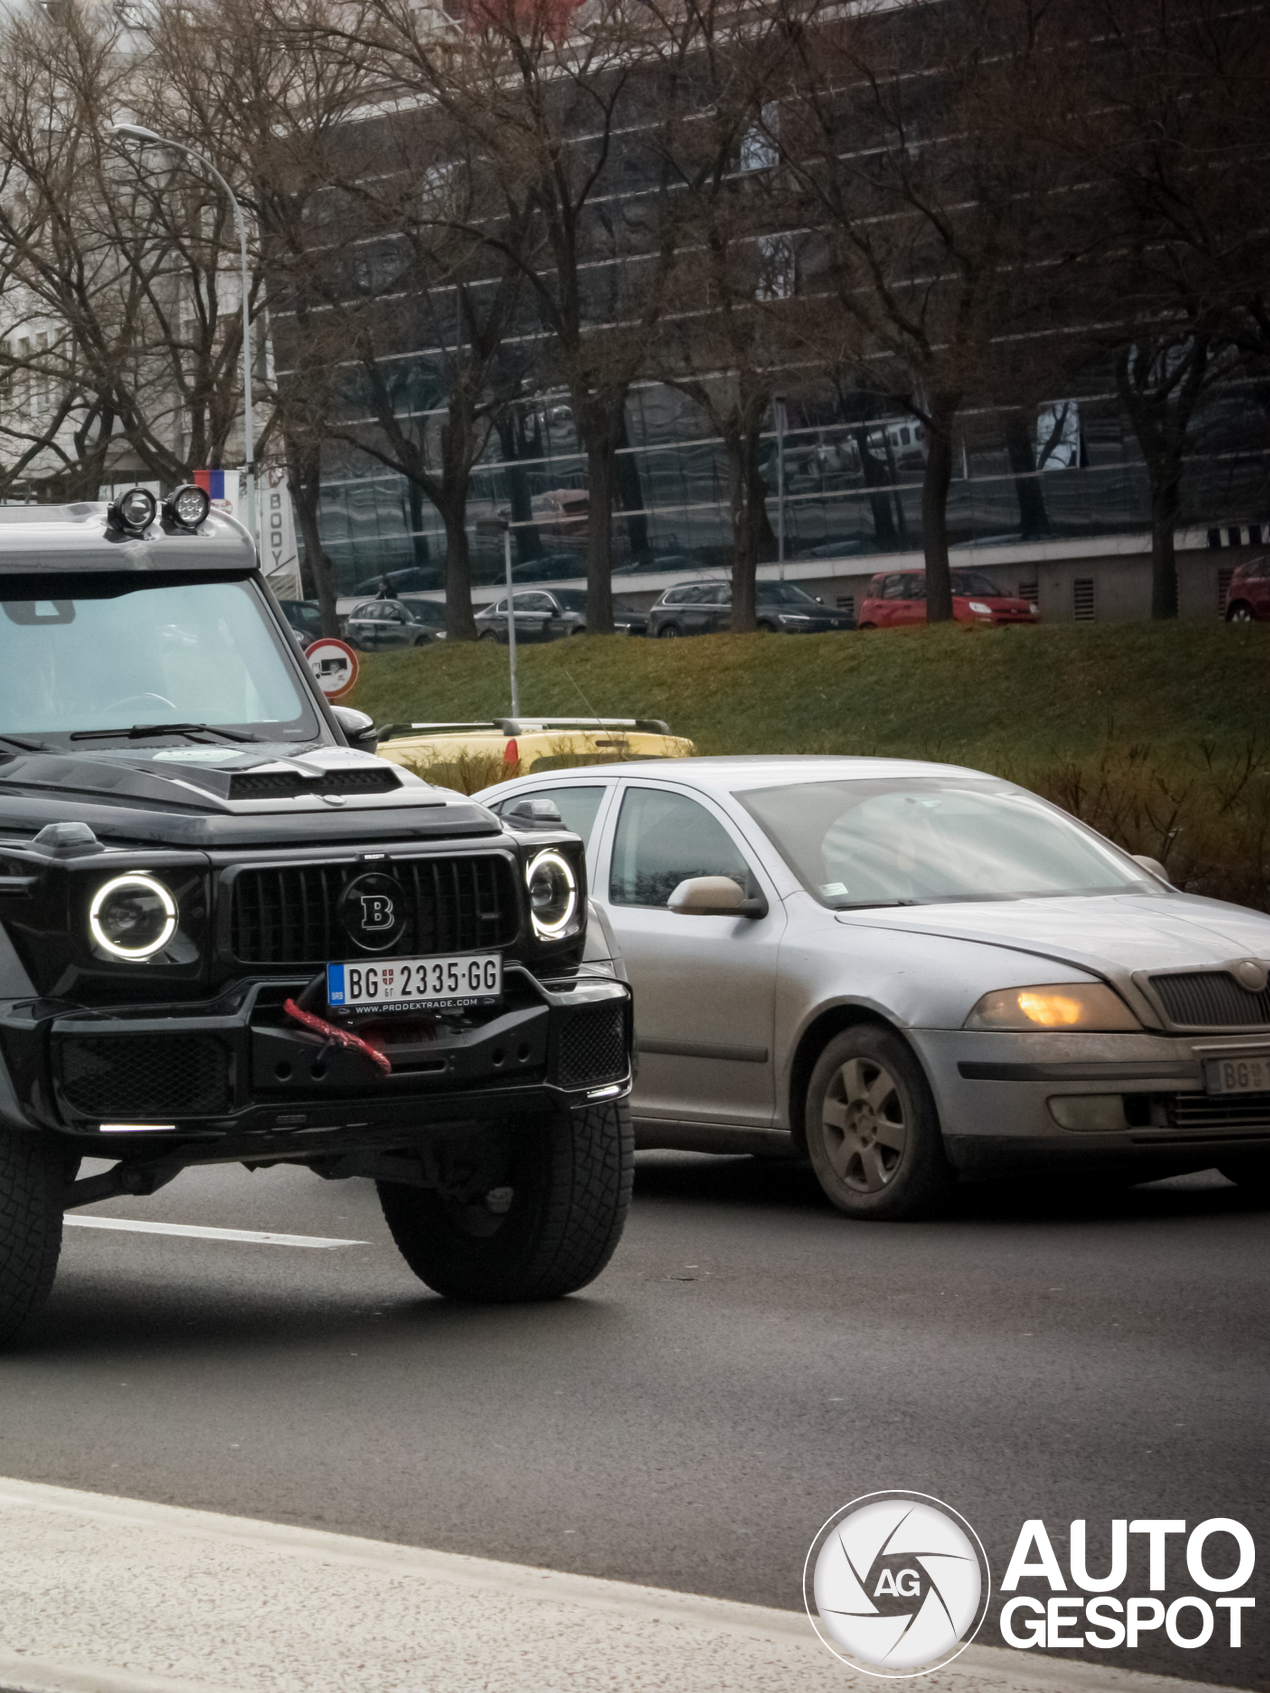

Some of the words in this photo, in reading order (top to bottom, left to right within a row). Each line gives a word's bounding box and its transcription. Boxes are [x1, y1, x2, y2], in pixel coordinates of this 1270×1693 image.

[270, 493, 282, 567] BODY
[349, 967, 378, 999] BG
[355, 998, 478, 1014] WWW.PRODEXTRADE.COM
[1223, 1061, 1249, 1090] BG
